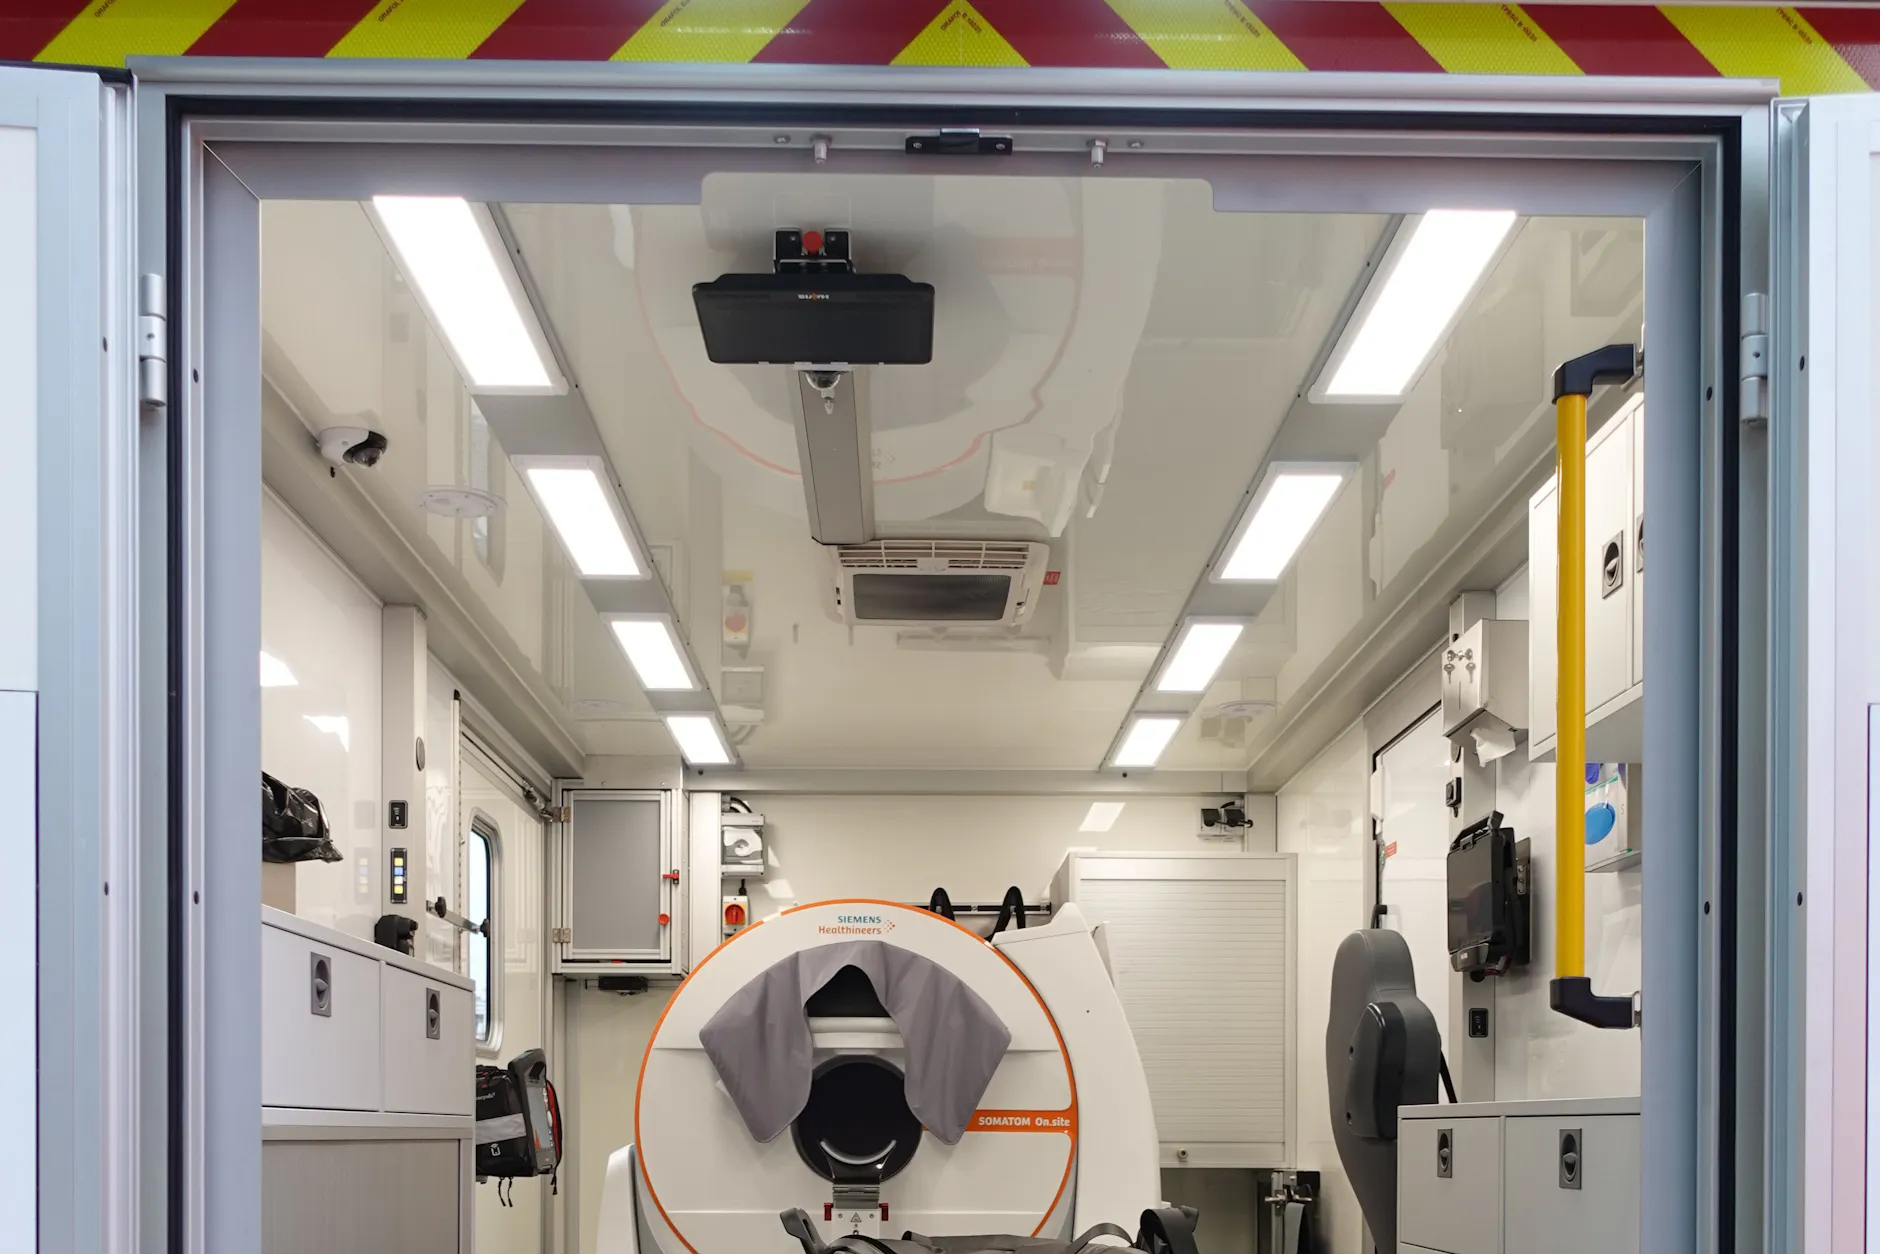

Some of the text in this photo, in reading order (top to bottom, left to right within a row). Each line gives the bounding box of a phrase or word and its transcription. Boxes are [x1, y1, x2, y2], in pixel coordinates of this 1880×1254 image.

[837, 915, 882, 924] SIEMENS
[818, 925, 882, 935] Healthineers
[978, 1116, 1071, 1127] SOMATOM On.site
